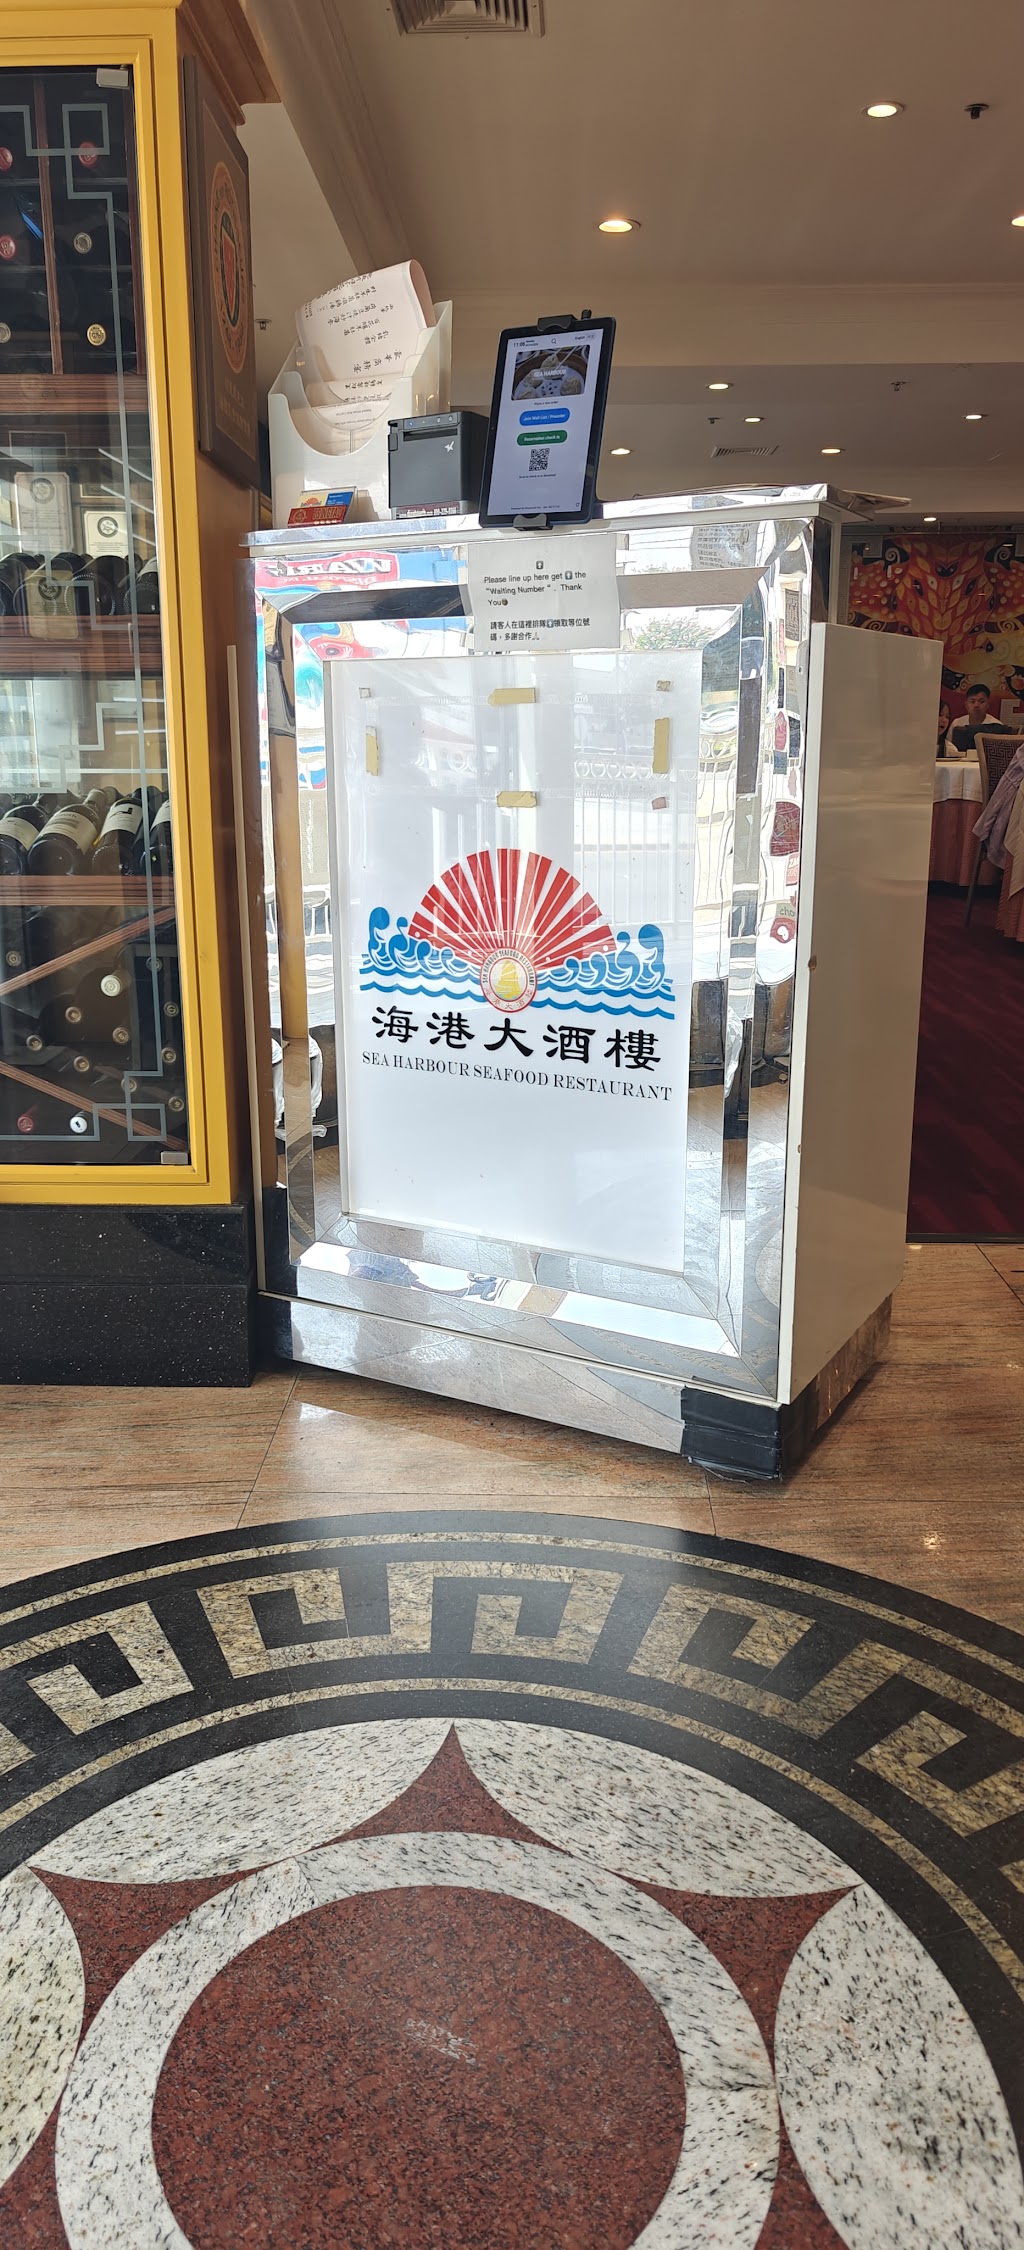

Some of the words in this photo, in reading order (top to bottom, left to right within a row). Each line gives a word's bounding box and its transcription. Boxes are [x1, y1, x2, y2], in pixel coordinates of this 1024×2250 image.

[518, 585, 545, 593] Number
[551, 573, 563, 582] get
[498, 949, 520, 959] SEAFOOD
[519, 954, 535, 986] RESTAURANT
[372, 1006, 661, 1072] 海港大酒樓
[362, 1050, 390, 1067] SEA
[393, 1054, 470, 1077] HARBOUR
[473, 1066, 548, 1086] SEAFOOD
[554, 1074, 672, 1102] RESTAURANT
